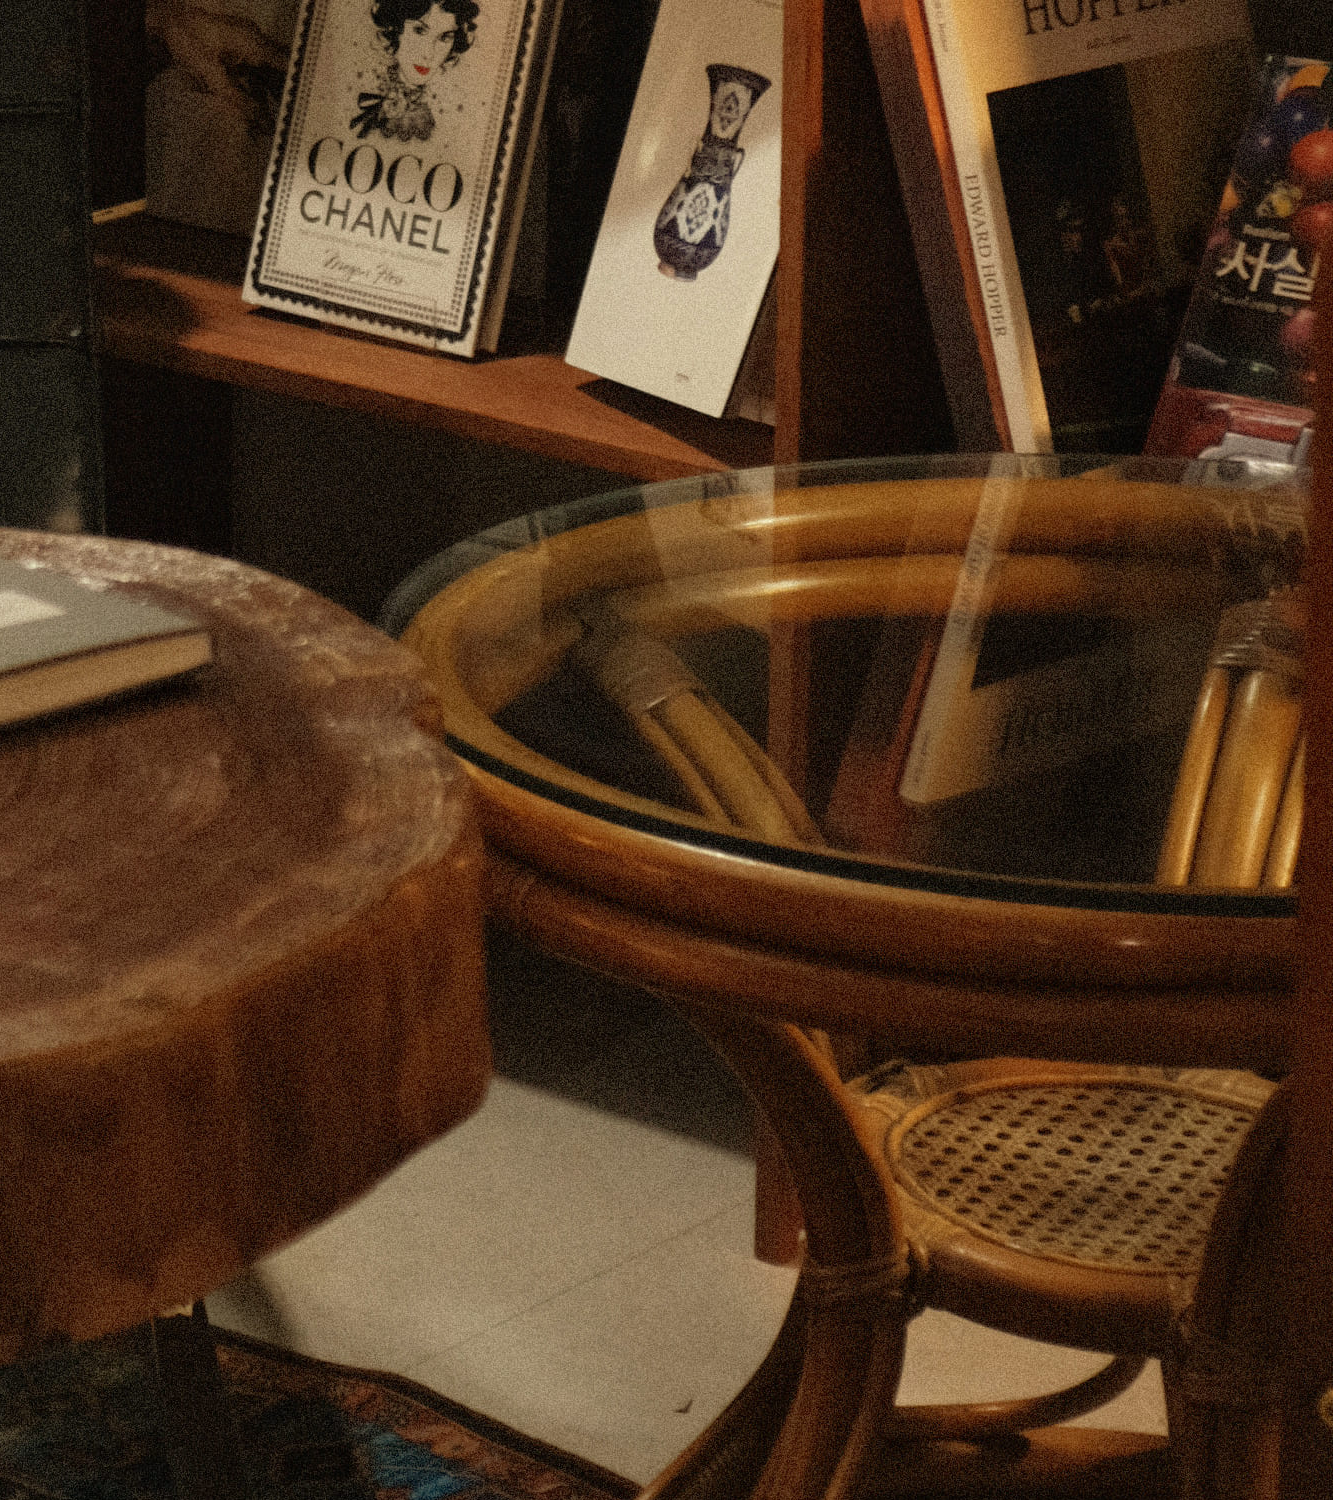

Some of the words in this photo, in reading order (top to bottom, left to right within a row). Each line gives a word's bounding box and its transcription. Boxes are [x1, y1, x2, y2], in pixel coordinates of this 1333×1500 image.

[306, 136, 464, 213] COCO
[299, 190, 451, 255] CHANEL
[964, 173, 994, 259] EDWARD
[983, 260, 1008, 340] HOPPER
